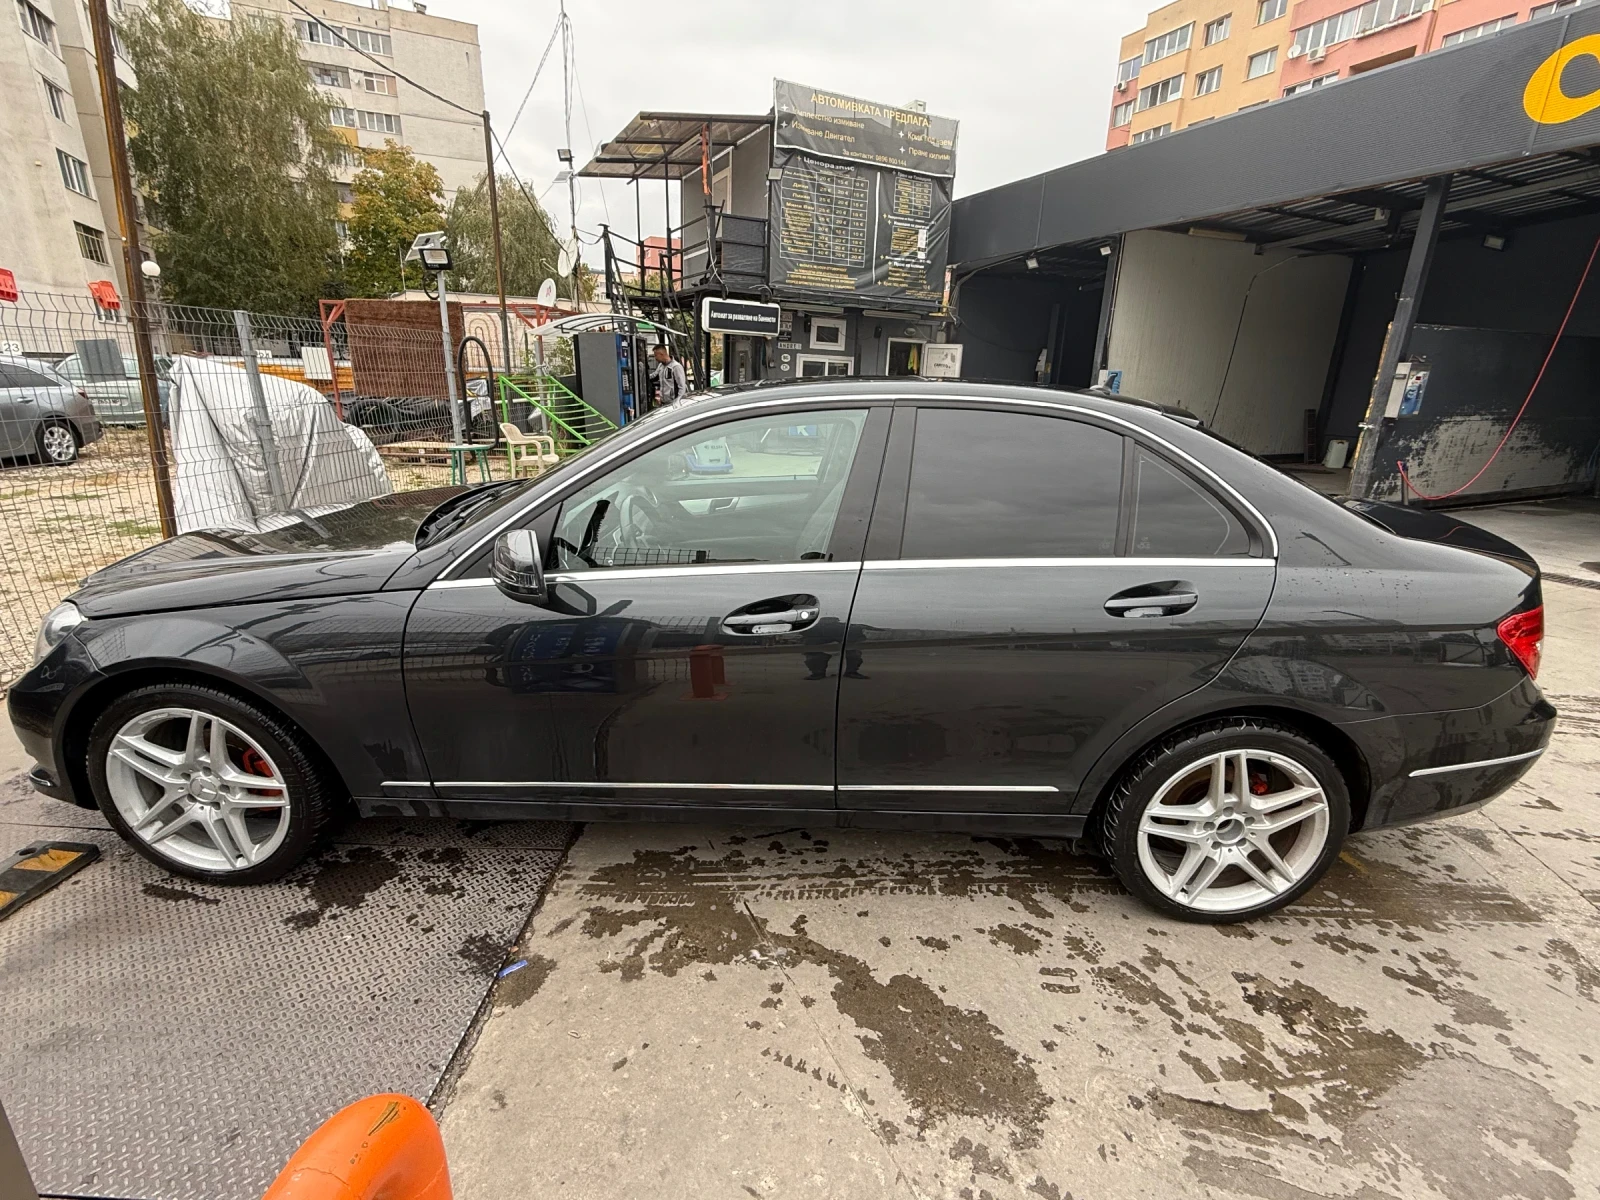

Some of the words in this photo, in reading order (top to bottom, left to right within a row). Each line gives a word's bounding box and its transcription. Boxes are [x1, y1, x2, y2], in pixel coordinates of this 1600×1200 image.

[811, 92, 882, 117] АВТОМИВКАТА
[834, 118, 864, 128] измиване
[824, 130, 855, 142] Двигател
[803, 156, 855, 171] Ценоразпис
[3, 342, 20, 353] 23
